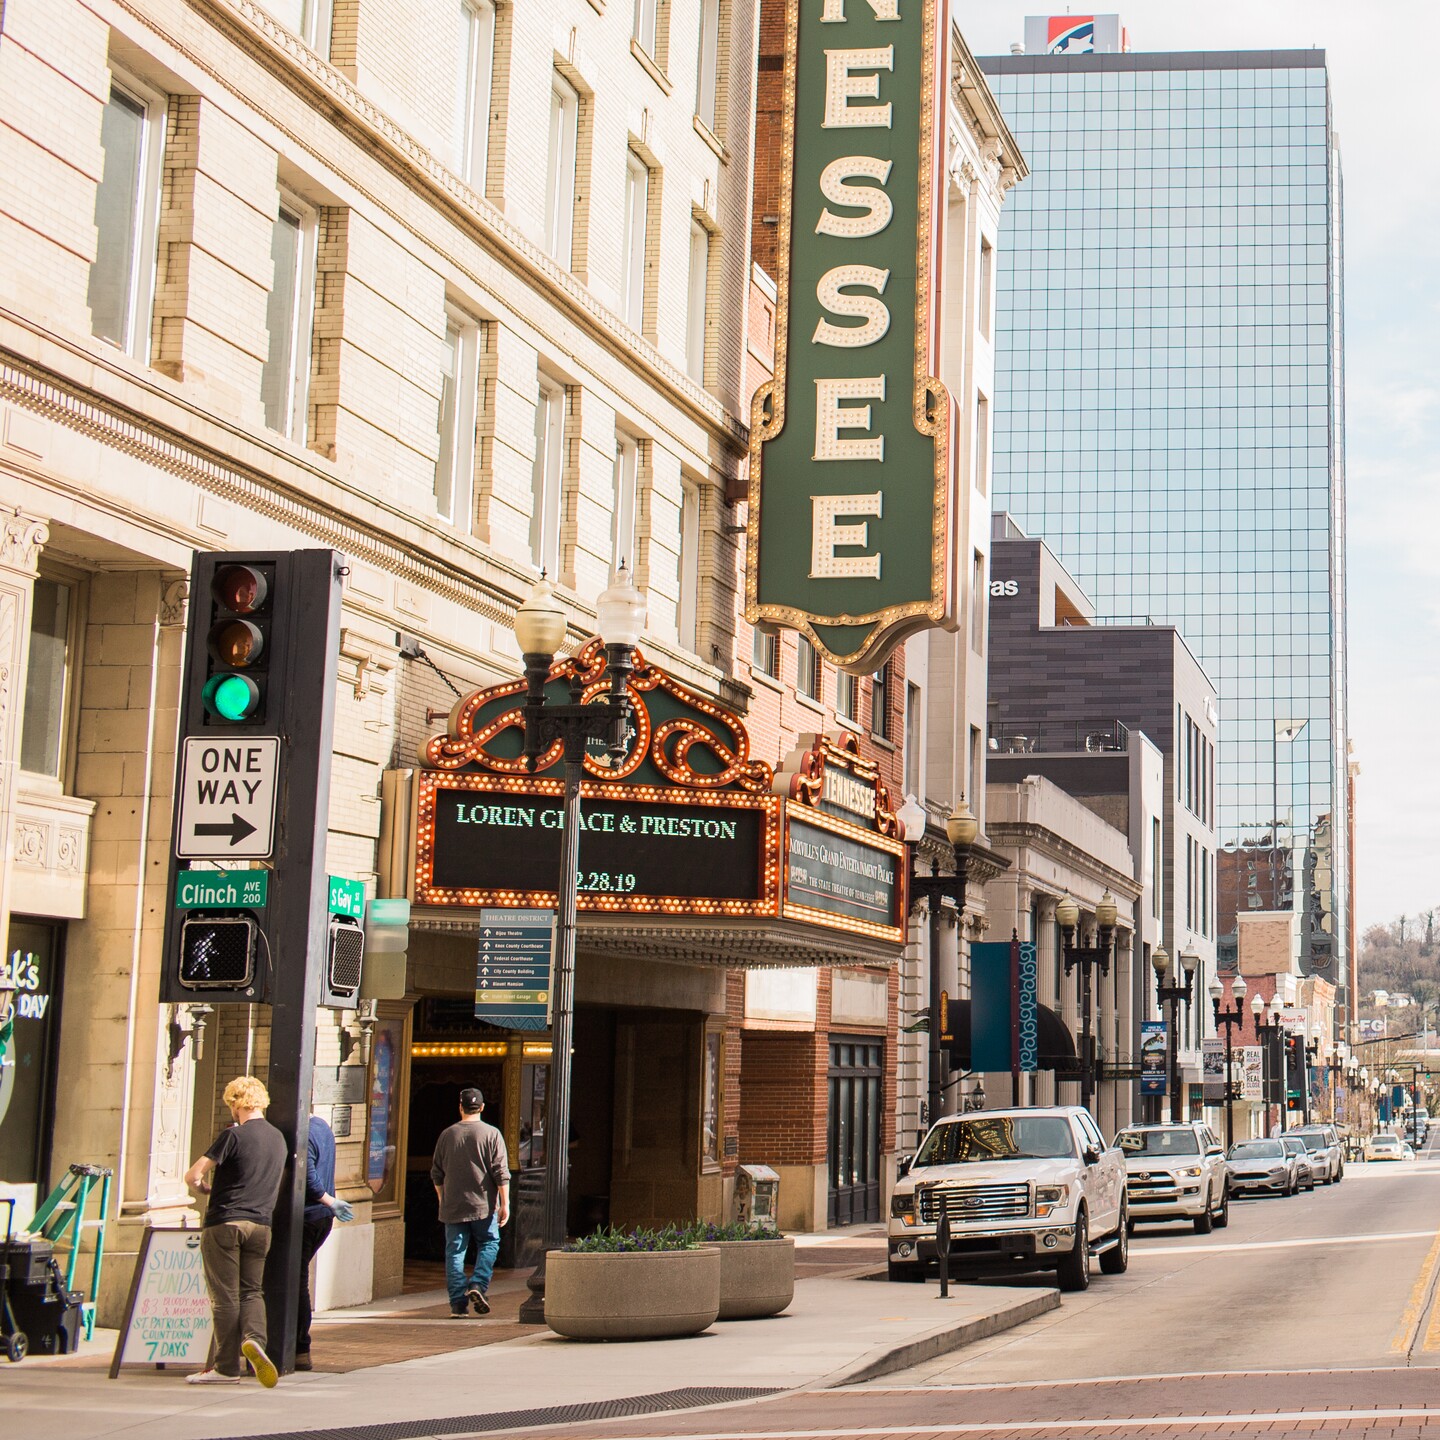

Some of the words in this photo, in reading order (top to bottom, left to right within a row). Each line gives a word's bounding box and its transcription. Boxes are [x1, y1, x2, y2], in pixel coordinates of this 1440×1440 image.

[807, 0, 902, 579] ESSEE
[990, 580, 1019, 596] as
[201, 748, 262, 773] ONE
[197, 780, 262, 804] WAY
[825, 769, 876, 819] TENNESSEE
[456, 804, 535, 827] LOREN
[619, 815, 636, 833] &
[641, 816, 737, 839] PRESTON
[789, 838, 819, 861] NOXVILLE'S
[819, 844, 838, 867] GRAND
[839, 851, 881, 880] ENTERTAINMENT
[877, 864, 893, 885] PALACE
[182, 884, 237, 904] Clinch
[244, 881, 260, 892] AVE
[809, 876, 818, 888] THE
[818, 879, 830, 892] STATE
[831, 882, 848, 896] THEATRE
[848, 886, 854, 897] OF
[242, 893, 261, 904] 200
[331, 888, 337, 906] S
[338, 889, 352, 915] Gay
[485, 914, 517, 922] THEATRE
[518, 914, 549, 922] DISTRICT
[19, 993, 49, 1020] DAY
[1360, 1020, 1384, 1032] FG
[149, 1249, 203, 1271] SUNDA
[142, 1298, 159, 1315] $3
[162, 1298, 189, 1306] BLOODY
[172, 1307, 205, 1315] MIMOSAS
[150, 1317, 191, 1329] PATRICKS
[193, 1317, 211, 1329] DAY
[142, 1329, 194, 1340] COUNTDOWN
[145, 1342, 159, 1361] 7
[160, 1342, 190, 1358] DAYS
